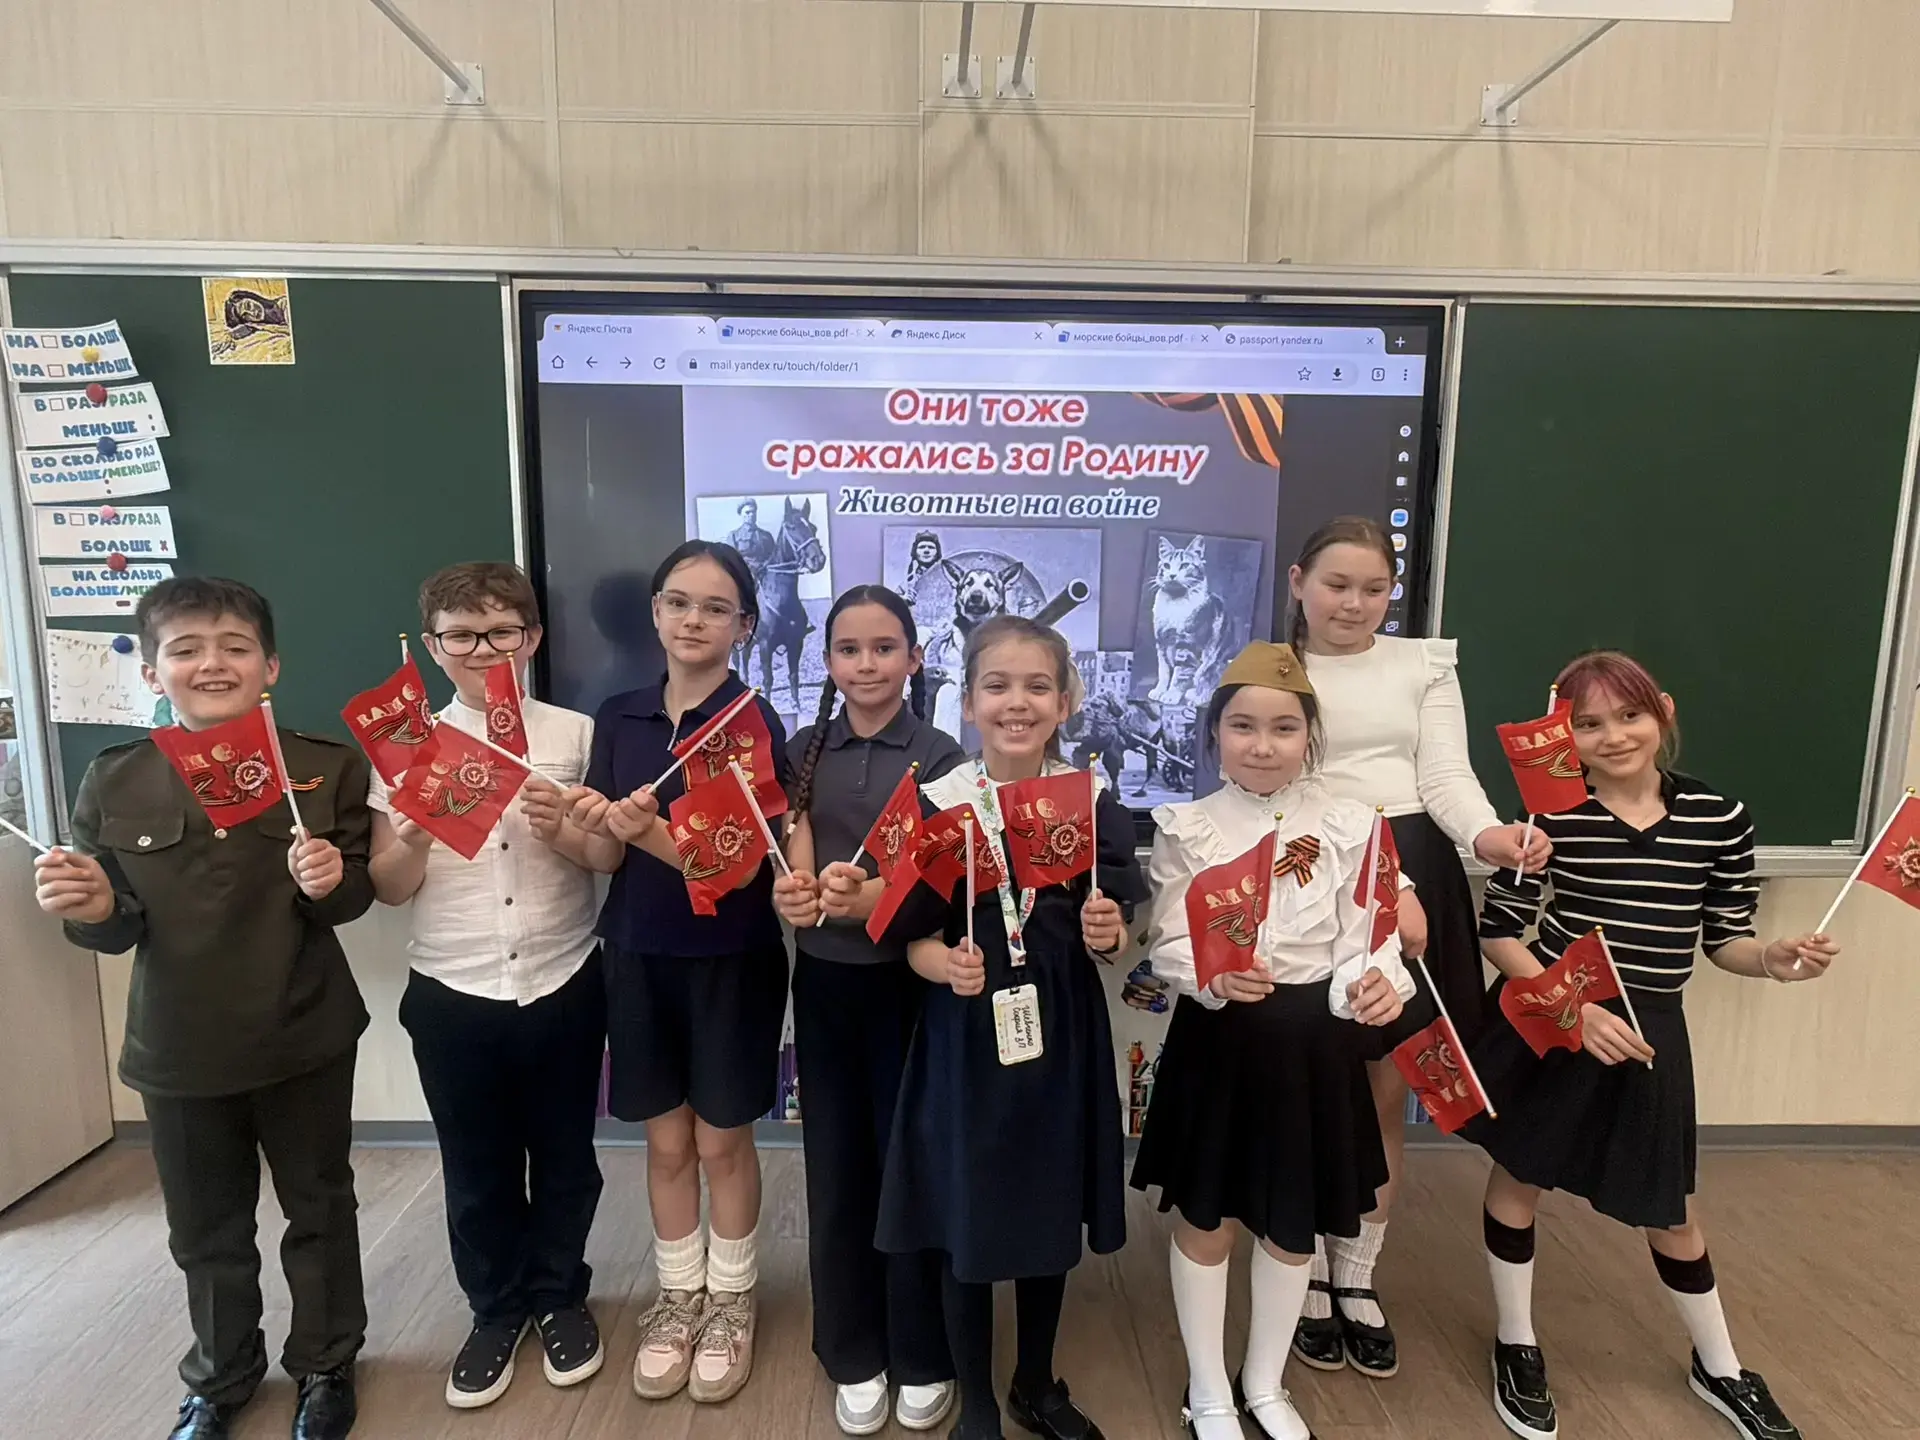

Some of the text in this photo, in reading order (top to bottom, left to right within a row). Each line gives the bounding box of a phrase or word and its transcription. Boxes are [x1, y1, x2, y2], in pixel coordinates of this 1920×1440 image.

[568, 324, 632, 334] Яндекс Почта
[738, 328, 778, 339] морские
[906, 330, 966, 340] Яндекс Диск
[6, 334, 39, 348] НА
[1074, 334, 1114, 344] морские
[12, 362, 45, 376] НА
[710, 359, 858, 372] mail.yandex.ru/touch/folder/1
[34, 398, 48, 412] В
[888, 388, 1086, 424] Они тоже
[62, 420, 138, 438] МЕНЬШЕ
[31, 456, 57, 468] ВО
[135, 444, 155, 459] РАЗ
[765, 440, 1206, 483] сражались за Родину
[30, 460, 161, 484] БОЛЬШЕ/МЕНЬШЕ?
[836, 489, 1160, 517] Животные на войне
[53, 512, 66, 525] В
[80, 540, 152, 552] БОЛЬШЕ
[72, 569, 162, 582] НА СКОЛЬКО
